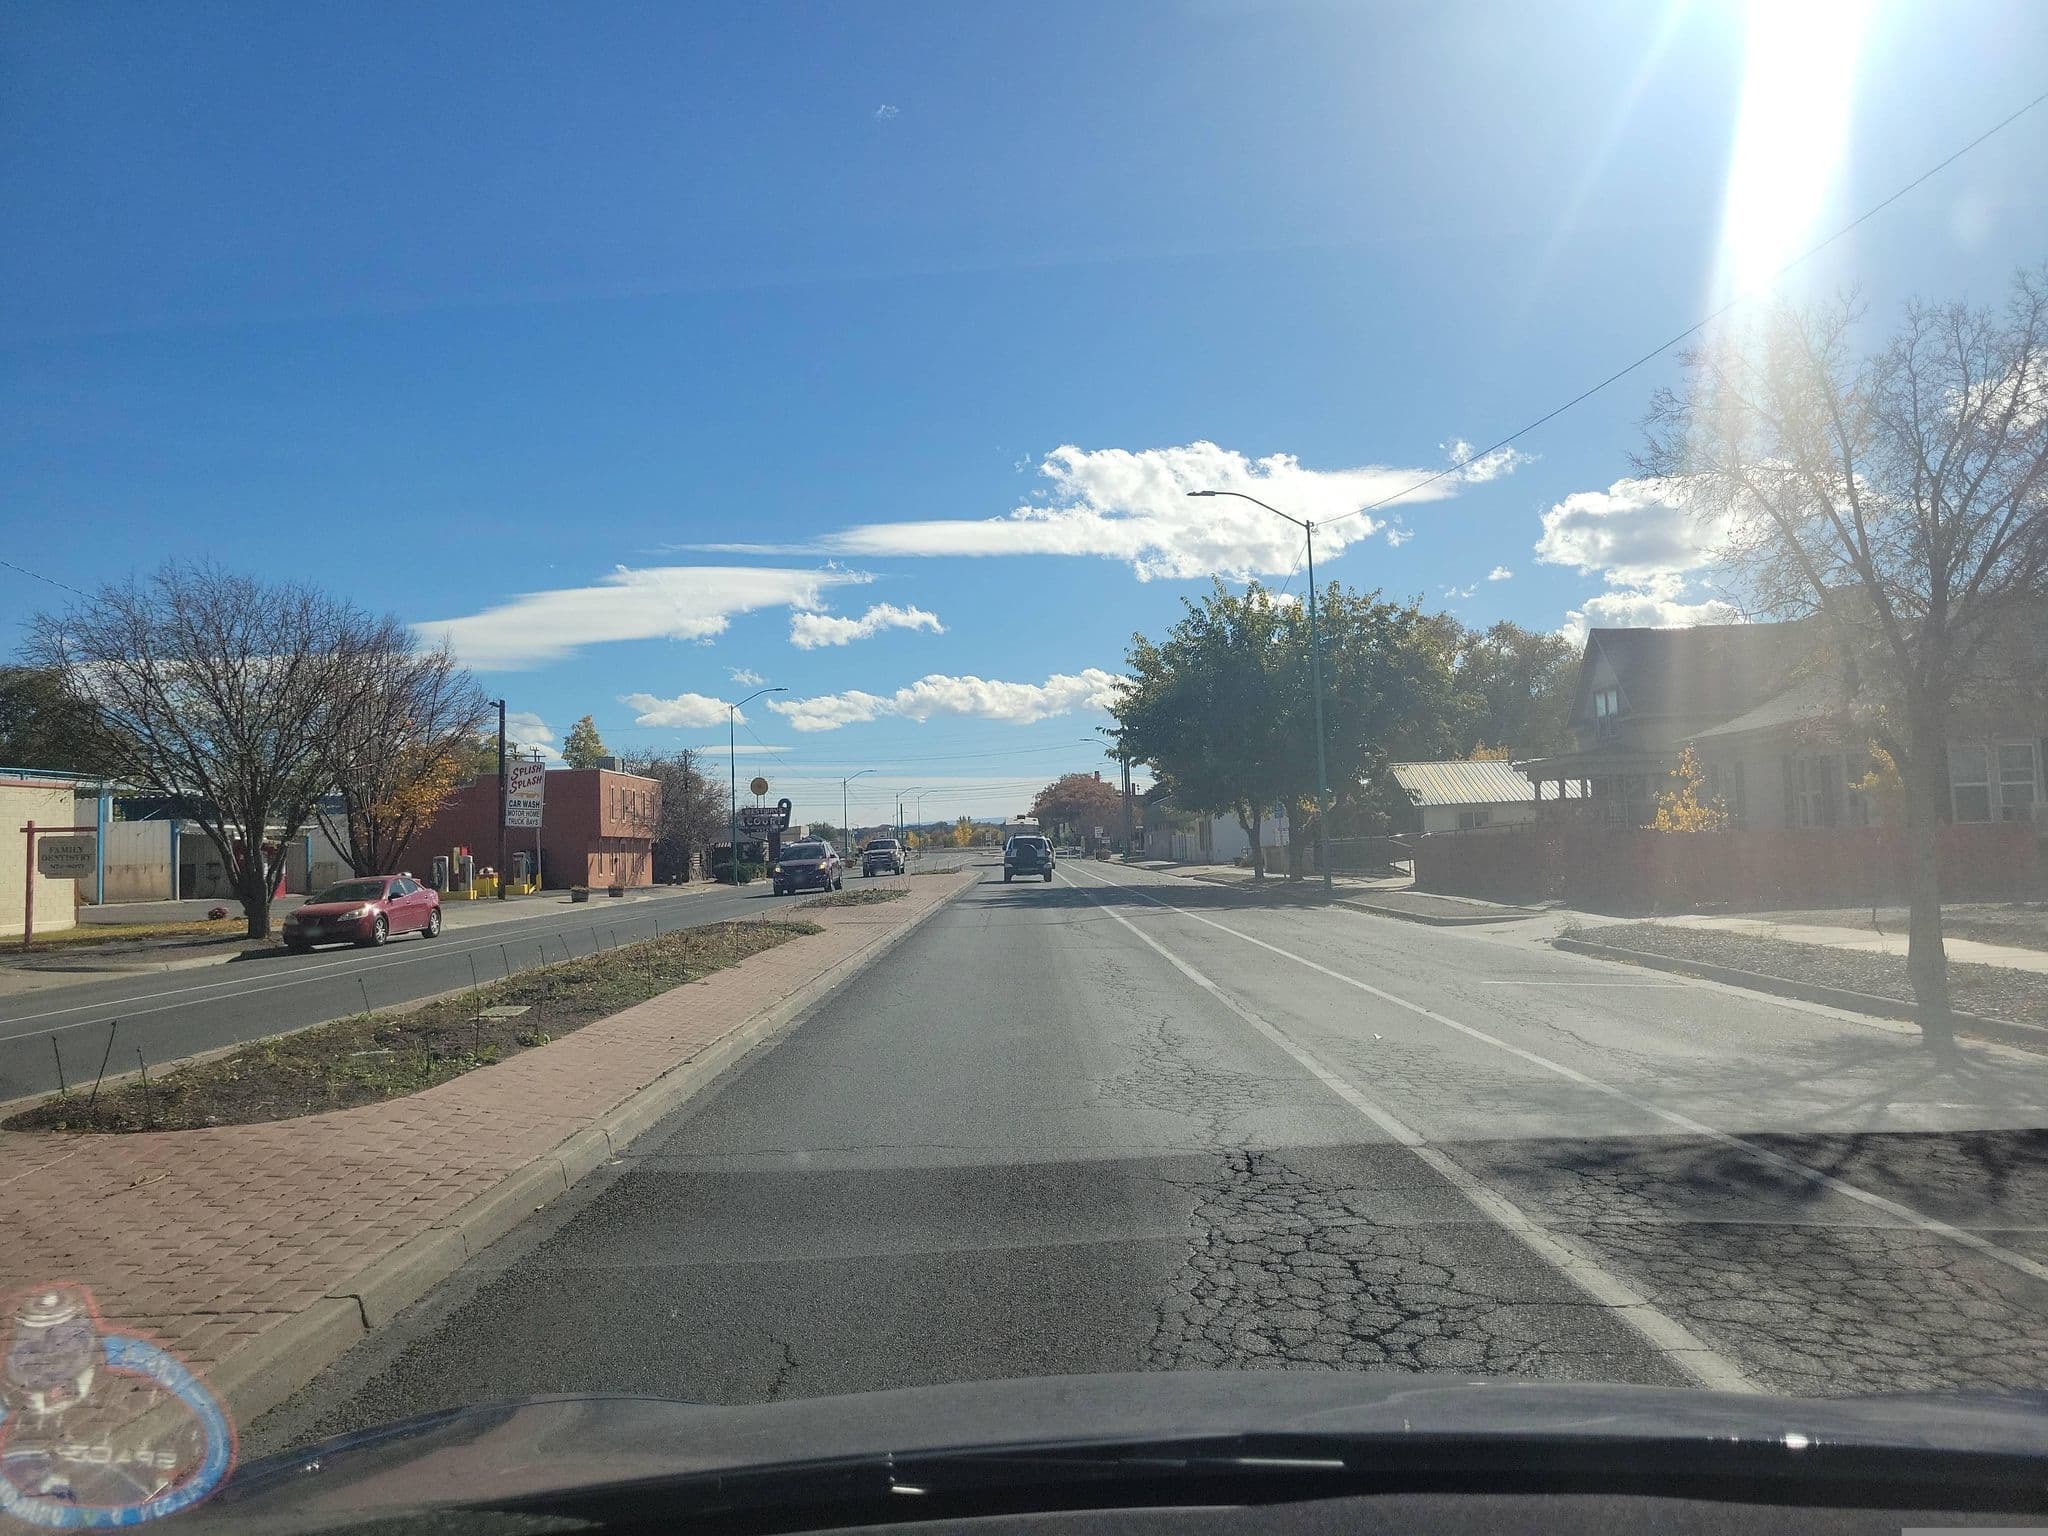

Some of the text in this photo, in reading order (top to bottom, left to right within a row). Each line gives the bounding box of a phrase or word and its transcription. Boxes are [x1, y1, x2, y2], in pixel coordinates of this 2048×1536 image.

[510, 764, 543, 781] SPLISH
[509, 775, 543, 794] SPLASH
[508, 800, 541, 809] CAR WASH
[508, 817, 525, 825] TRUCK
[48, 846, 84, 854] FAMILY
[41, 854, 90, 862] DENTISTRY
